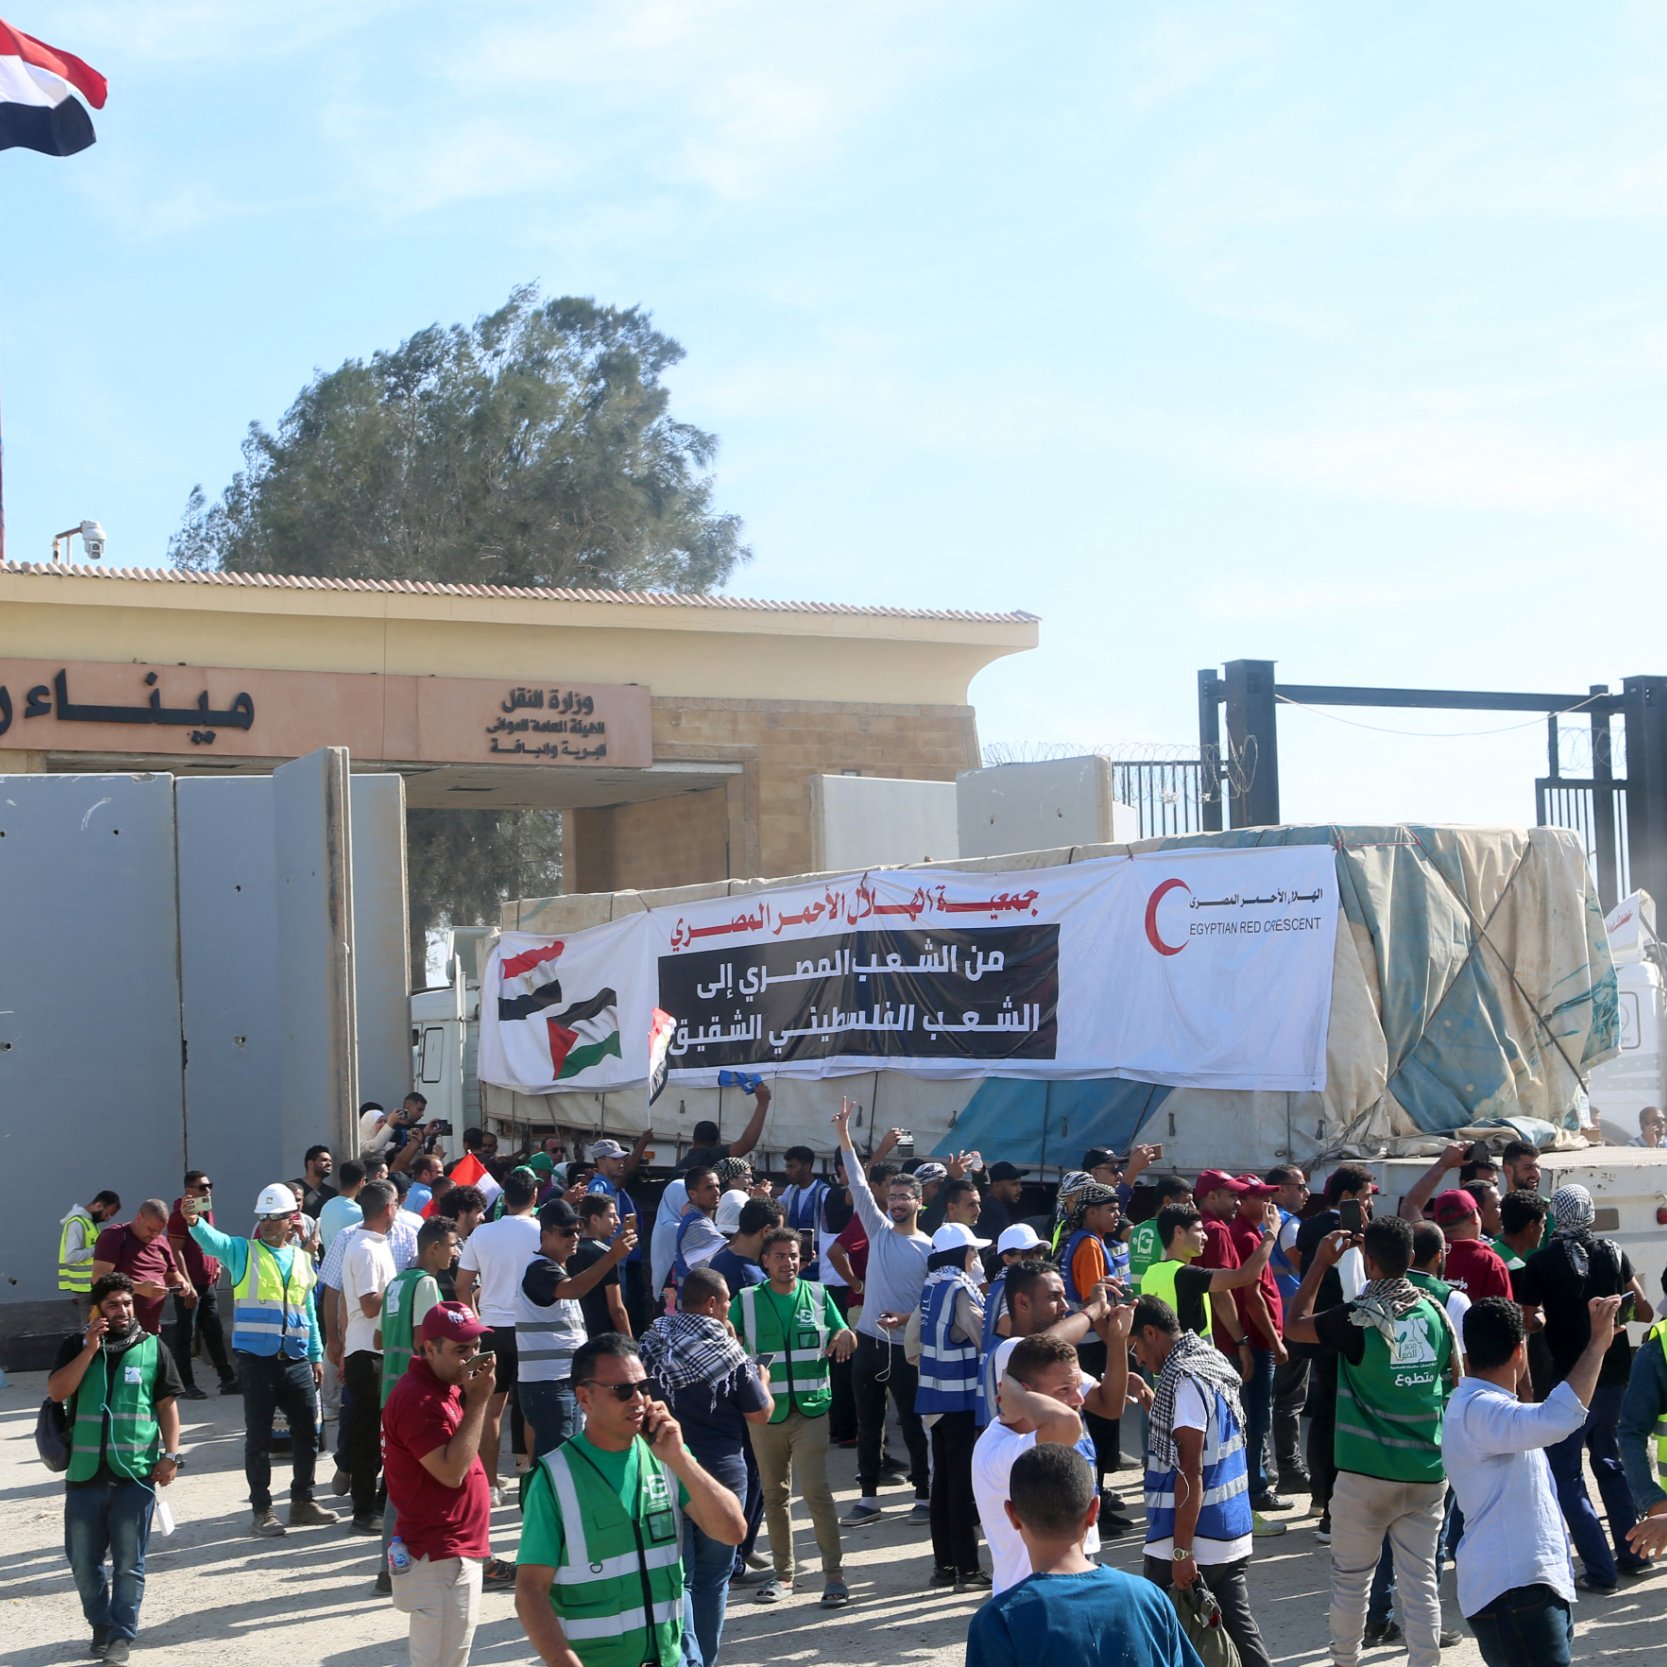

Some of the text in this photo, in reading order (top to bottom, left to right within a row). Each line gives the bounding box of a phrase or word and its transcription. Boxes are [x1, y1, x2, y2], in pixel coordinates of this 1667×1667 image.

[501, 687, 594, 715] وزارة النقل
[670, 885, 1040, 952] جمعية الهلال الأحمر المصري
[1189, 916, 1322, 936] EGYPTIAN RED CRESCENT
[697, 938, 1005, 1003] من الشعب المصري إلى
[667, 996, 1040, 1056] الشعب الفلسطيني الشقيق
[1395, 1371, 1434, 1387] متطوع
